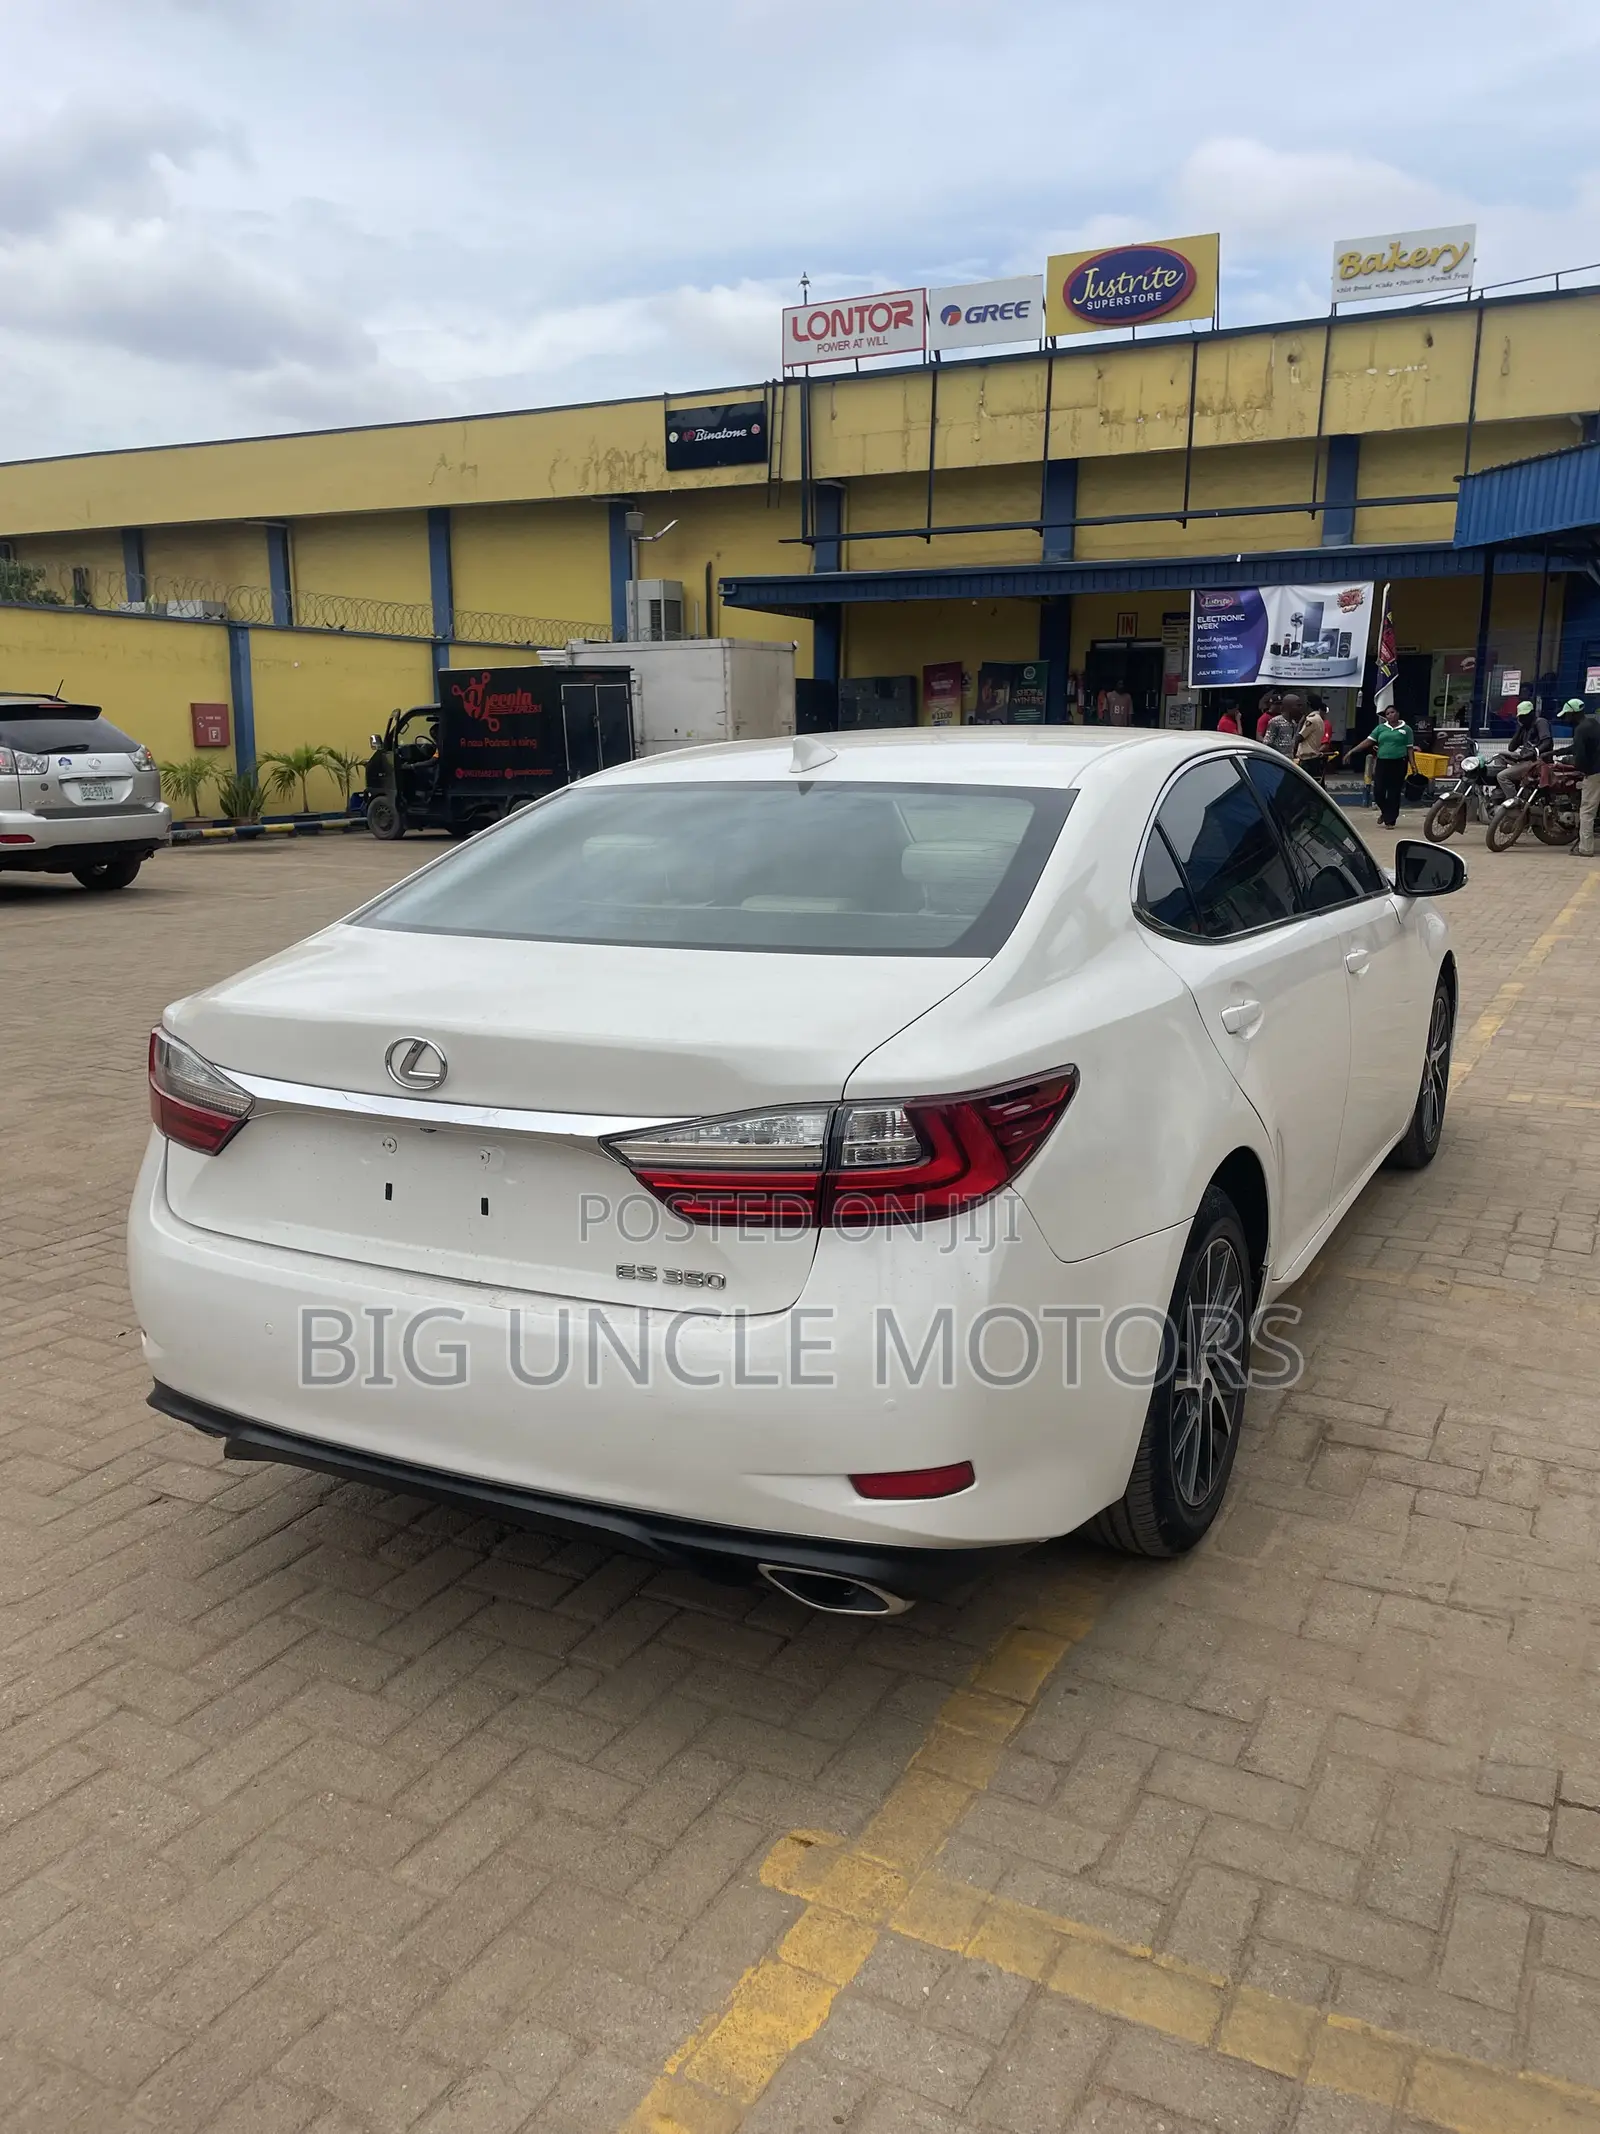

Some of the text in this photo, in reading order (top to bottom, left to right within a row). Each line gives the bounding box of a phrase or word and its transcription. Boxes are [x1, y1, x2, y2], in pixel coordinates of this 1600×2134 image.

[1338, 240, 1470, 280] Bakery
[1072, 265, 1184, 305] Justrite
[1086, 292, 1163, 311] SUPERSTORE
[791, 299, 915, 343] LONTOR
[964, 300, 1031, 324] GREE
[816, 335, 889, 355] POWER AT WILL
[694, 428, 748, 442] Binatone
[1121, 616, 1133, 635] IN
[1197, 614, 1245, 624] ELECTRONIC
[1197, 622, 1219, 630] WEEK
[212, 730, 217, 739] F
[616, 1263, 727, 1290] ES 350
